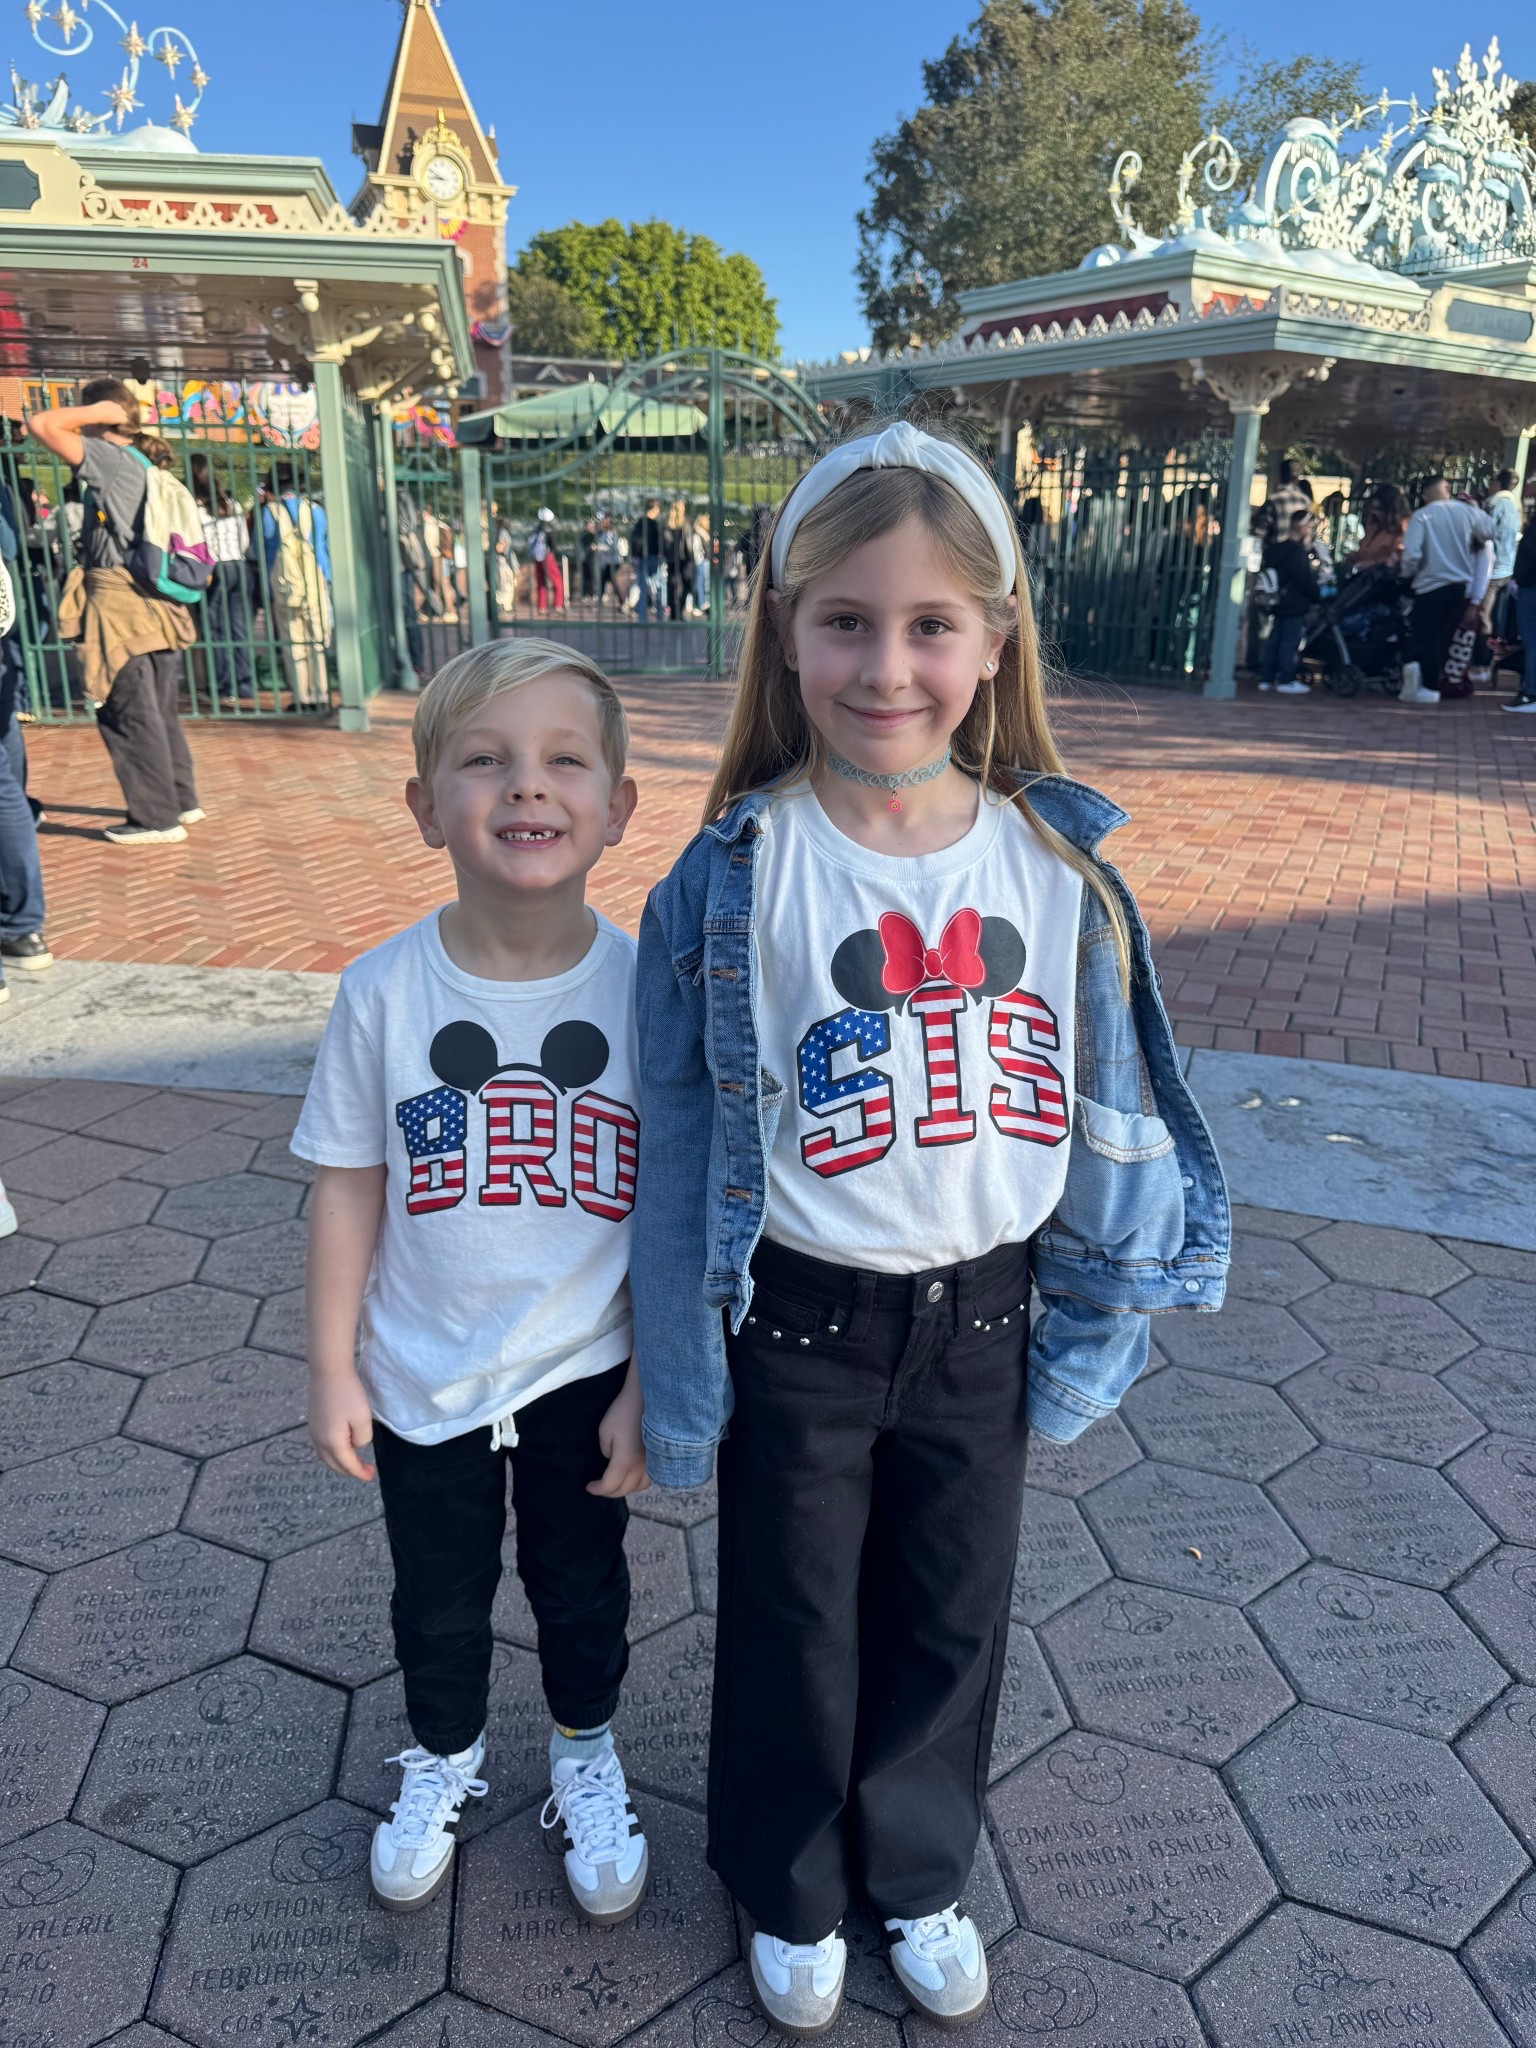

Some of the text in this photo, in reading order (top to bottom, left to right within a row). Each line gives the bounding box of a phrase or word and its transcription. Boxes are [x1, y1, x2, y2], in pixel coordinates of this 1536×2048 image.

[132, 256, 149, 269] 24
[798, 983, 1070, 1179] SIS
[396, 1080, 641, 1224] BRO
[74, 1585, 227, 1609] KELLY IRELAND
[72, 1602, 217, 1626] PR GEORGE BC
[74, 1628, 128, 1647] JULY
[1095, 1673, 1184, 1698] JANUARY
[1216, 1664, 1255, 1683] 2011
[640, 1708, 690, 1730] JUNE
[120, 1735, 159, 1752] THE
[622, 1730, 710, 1755] SACRAM
[127, 1749, 302, 1776] SALEM OREGON
[485, 1745, 550, 1767] TEXAS
[493, 1783, 529, 1800] 609
[1286, 1779, 1437, 1814] FINN WILLIAM
[131, 1820, 171, 1835] C08
[1334, 1808, 1424, 1837] FRAIZER
[1055, 1872, 1156, 1902] AUTUMN
[1187, 1862, 1231, 1885] IAN
[1359, 1886, 1398, 1906] C08
[209, 1896, 325, 1925] LAYTHON
[17, 1913, 114, 1941] VALERIE
[500, 1917, 592, 1943] MARCH
[633, 1906, 686, 1931] 1974
[1096, 1919, 1136, 1941] C08
[189, 1957, 330, 1991] FEBRUARY
[522, 1981, 564, 2003] C08
[220, 2002, 374, 2035] C08 608
[1269, 2000, 1434, 2047] THE ZAVACKY
